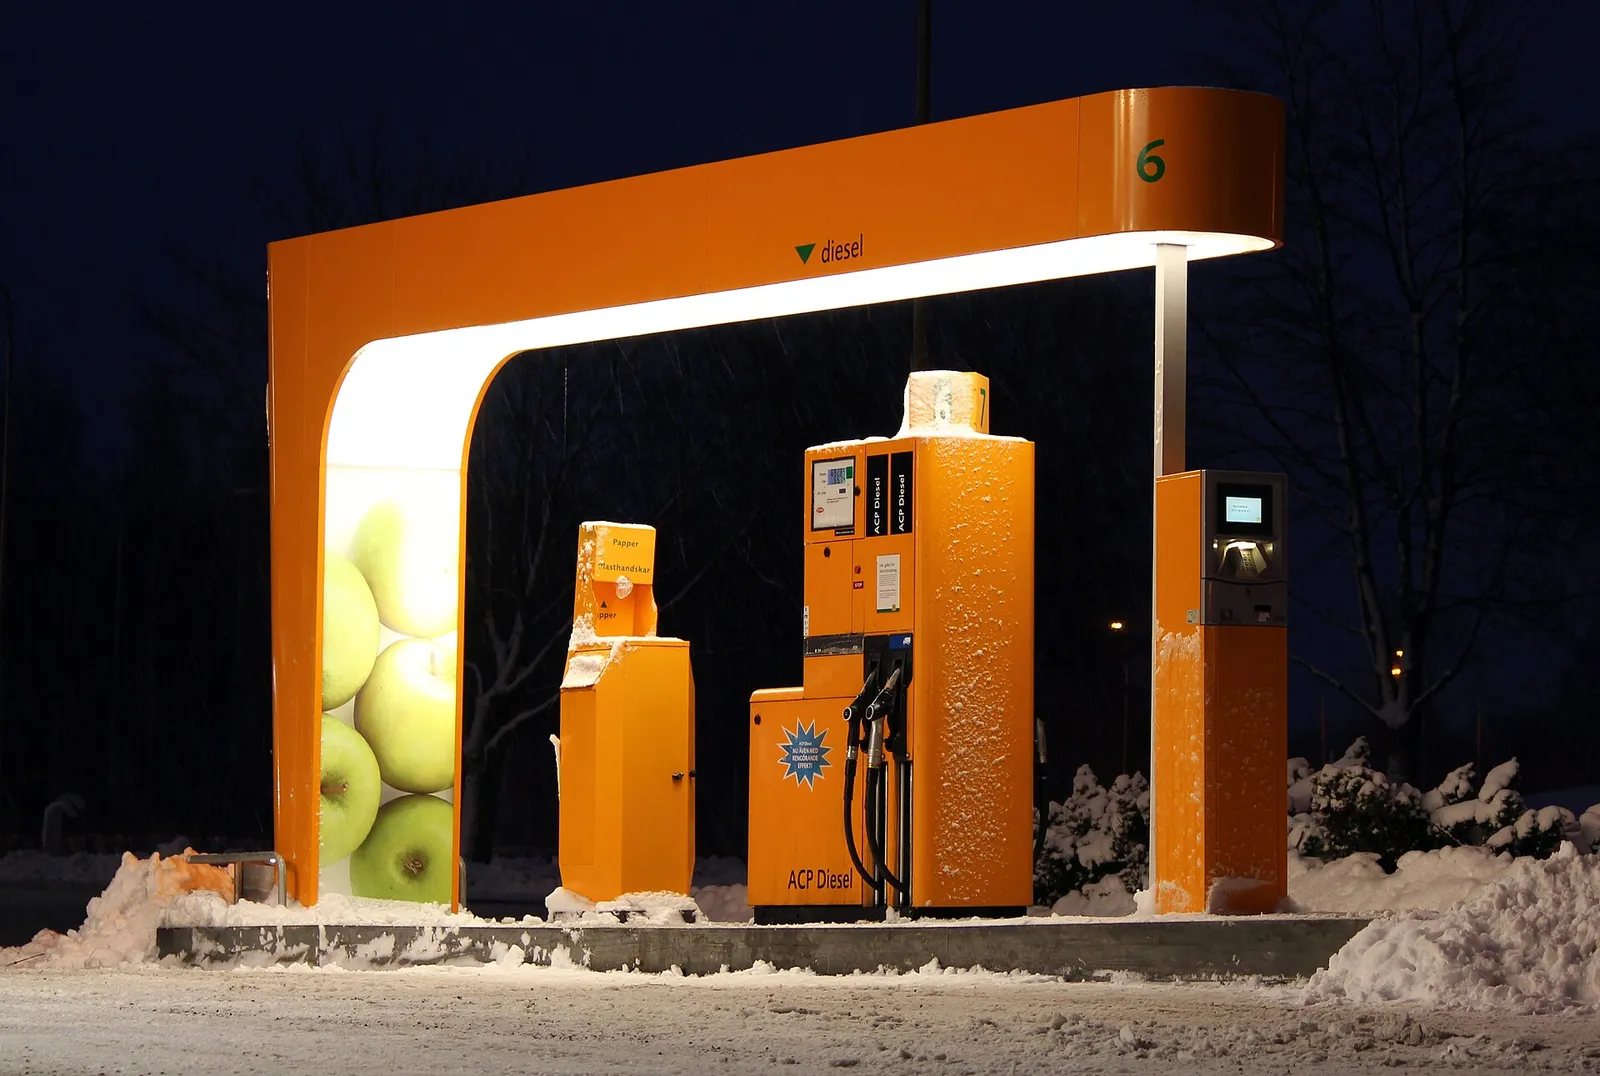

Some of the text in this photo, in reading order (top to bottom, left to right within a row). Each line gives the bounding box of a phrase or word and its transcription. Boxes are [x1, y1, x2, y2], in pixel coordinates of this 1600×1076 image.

[1136, 138, 1166, 183] 6
[821, 233, 863, 264] diesel
[873, 477, 881, 535] ACP Diesel
[612, 538, 639, 548] Papper
[597, 612, 616, 620] pper
[788, 867, 853, 890] ACP Diesel
